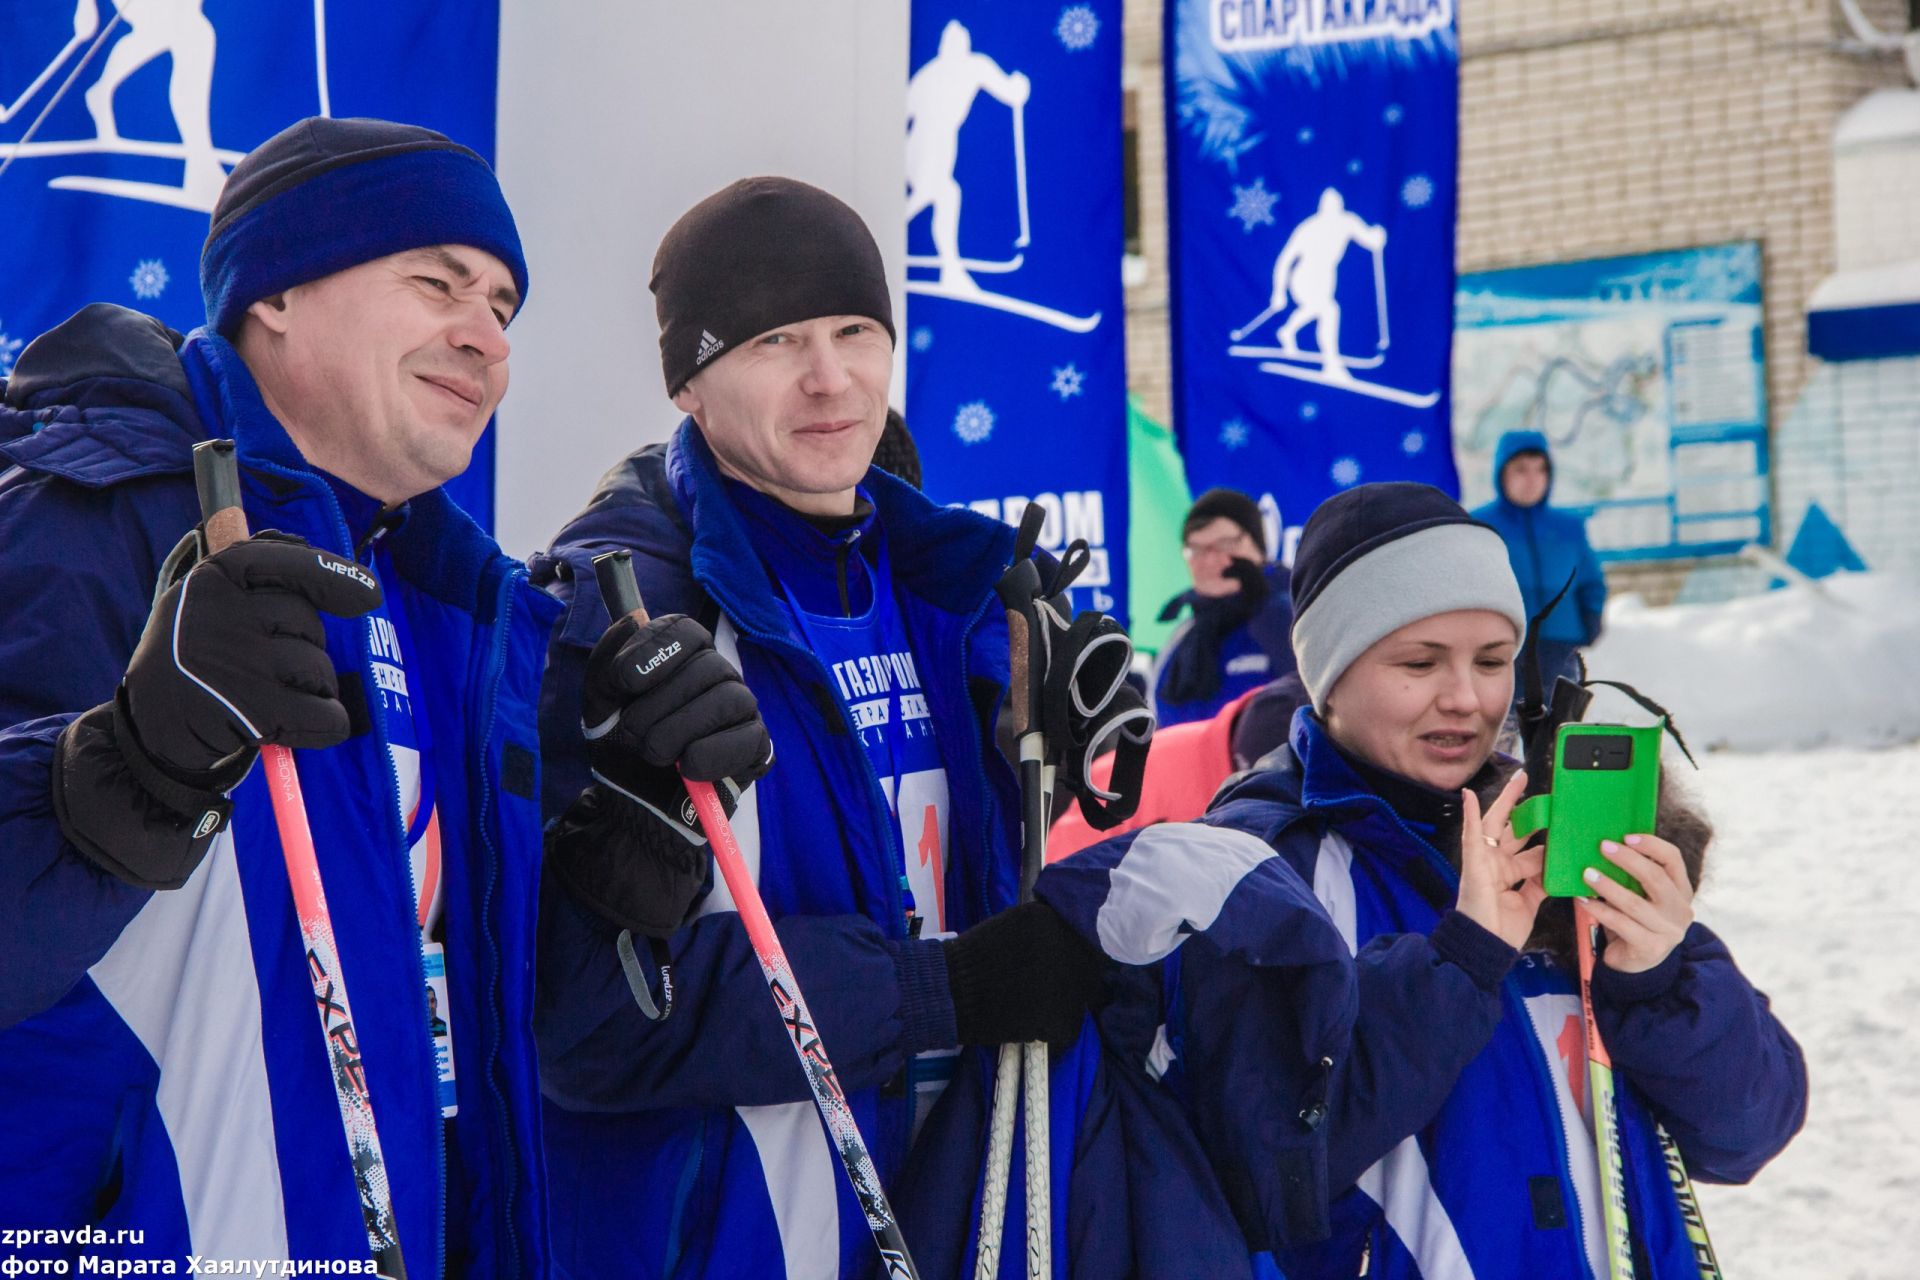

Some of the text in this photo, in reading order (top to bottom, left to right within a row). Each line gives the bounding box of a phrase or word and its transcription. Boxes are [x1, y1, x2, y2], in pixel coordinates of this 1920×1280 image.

[696, 340, 724, 366] adidas
[306, 948, 371, 1106] EXPE
[769, 977, 846, 1105] EXPE
